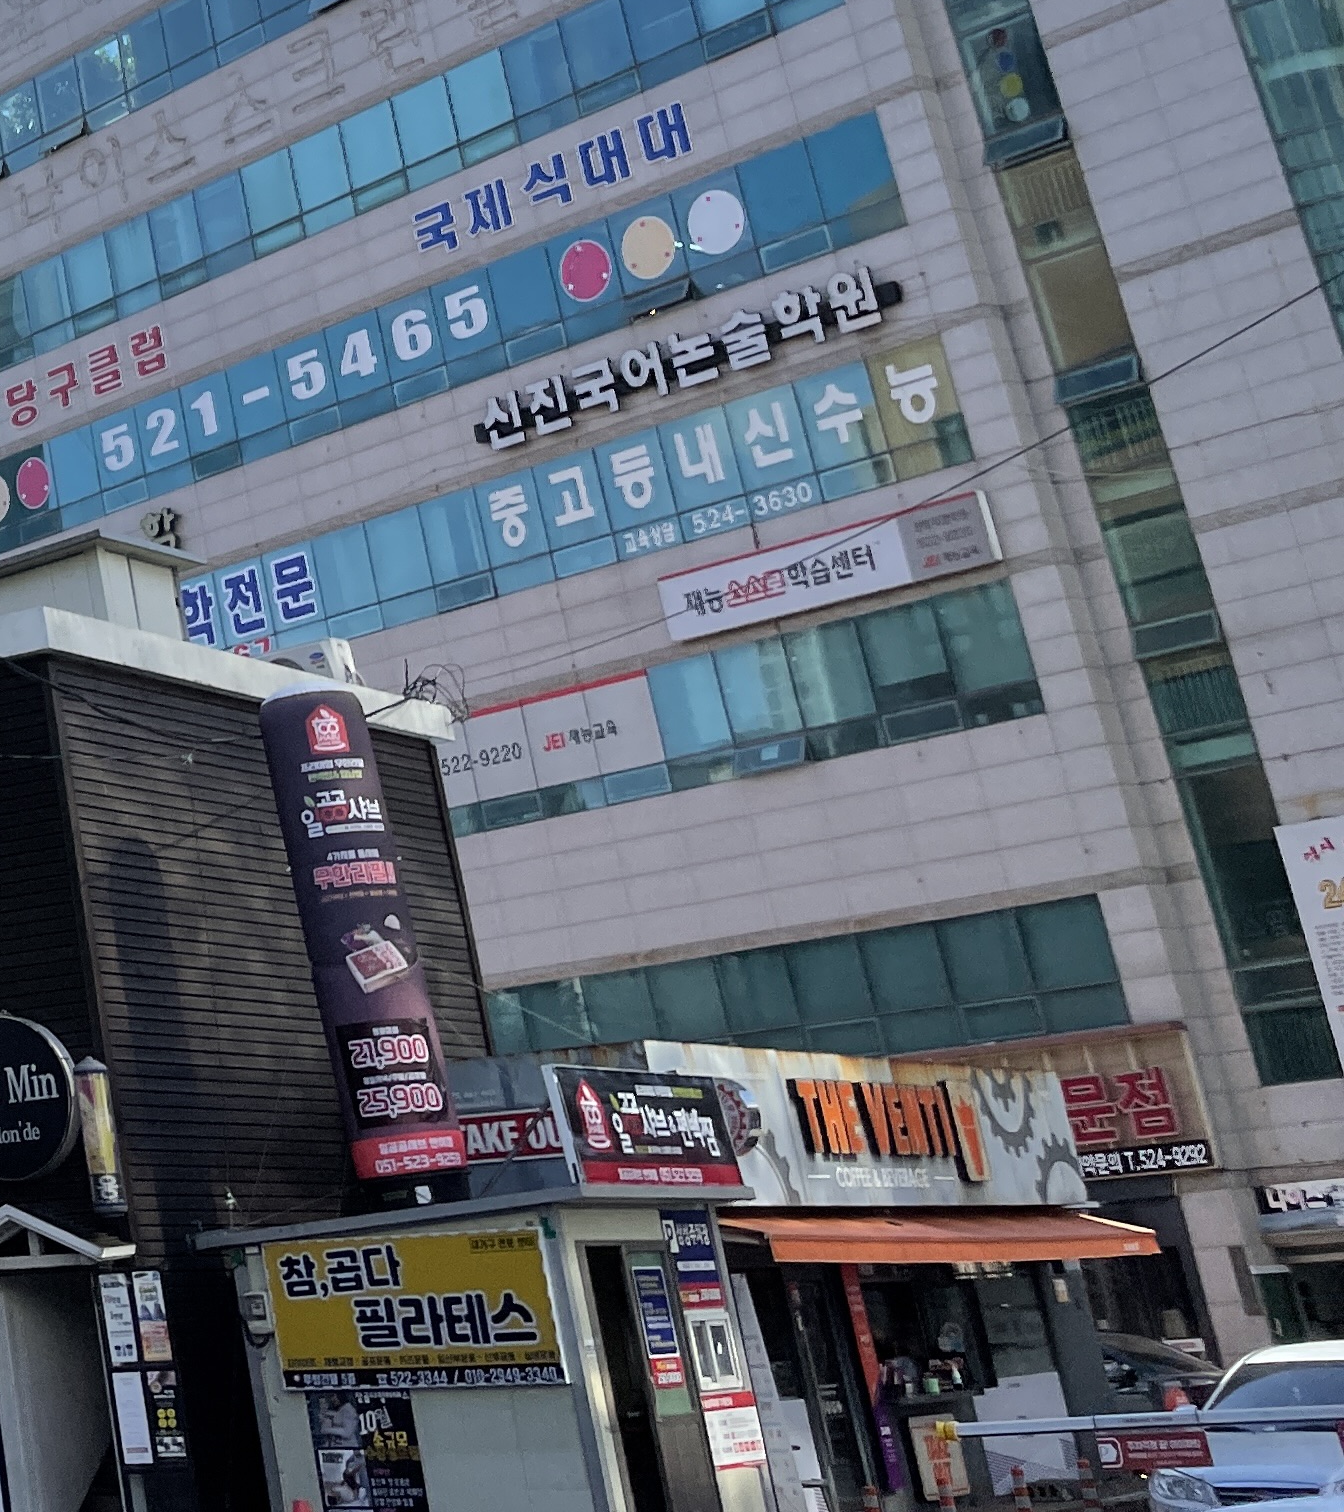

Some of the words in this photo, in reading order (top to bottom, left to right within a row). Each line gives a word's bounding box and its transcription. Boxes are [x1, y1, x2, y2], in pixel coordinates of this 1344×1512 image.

[100, 284, 491, 474] 521-5465
[477, 265, 885, 451] 신진국어논술학원
[690, 481, 814, 536] 524-3630
[440, 741, 523, 777] 522-9220
[348, 1034, 430, 1070] 21,900
[4, 1064, 60, 1103] Min
[356, 1082, 443, 1119] 25,900
[796, 1078, 865, 1155] THE
[860, 1081, 958, 1157] VENTI
[352, 1291, 539, 1349] 필라테스
